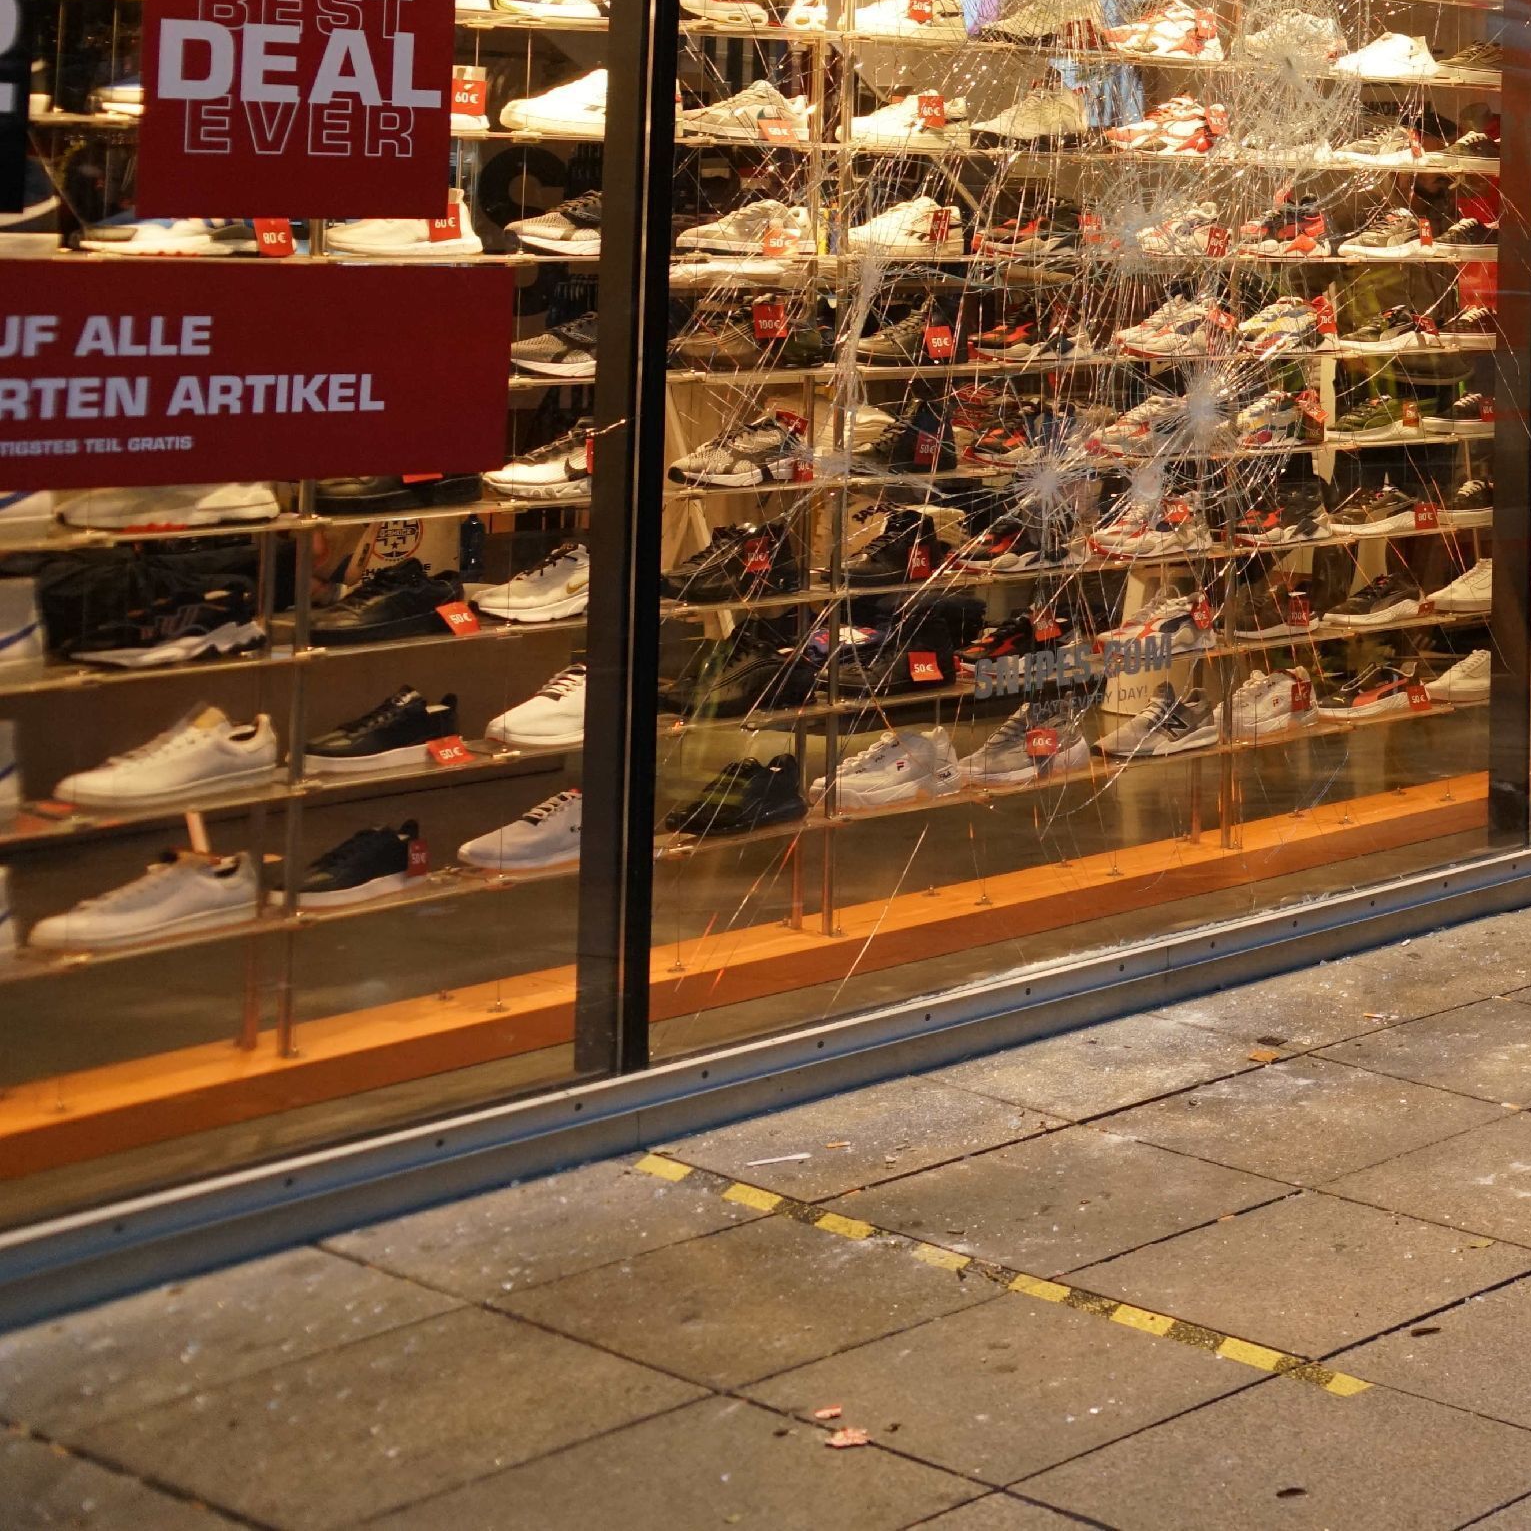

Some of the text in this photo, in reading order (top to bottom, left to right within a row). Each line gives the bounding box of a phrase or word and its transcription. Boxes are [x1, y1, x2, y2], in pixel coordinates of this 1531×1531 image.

[158, 18, 441, 108] DEAL
[455, 91, 479, 105] 60€
[184, 95, 413, 158] EVER
[262, 231, 286, 245] 80€
[769, 237, 793, 248] 50€
[758, 319, 782, 330] 100€
[75, 316, 212, 357] ALLE
[931, 336, 951, 348] 50€
[167, 373, 385, 416] ARTIKEL
[84, 437, 122, 453] TEIL
[128, 435, 193, 451] GRATIS
[920, 443, 938, 455] 50€
[449, 612, 472, 624] 50€
[914, 663, 935, 673] 50€
[975, 633, 1173, 700] SNIPES.COM
[1118, 685, 1149, 703] DAY!
[1411, 694, 1427, 704] 50€
[1032, 736, 1053, 747] 60€
[439, 746, 464, 759] 50€
[412, 851, 427, 864] 50€
